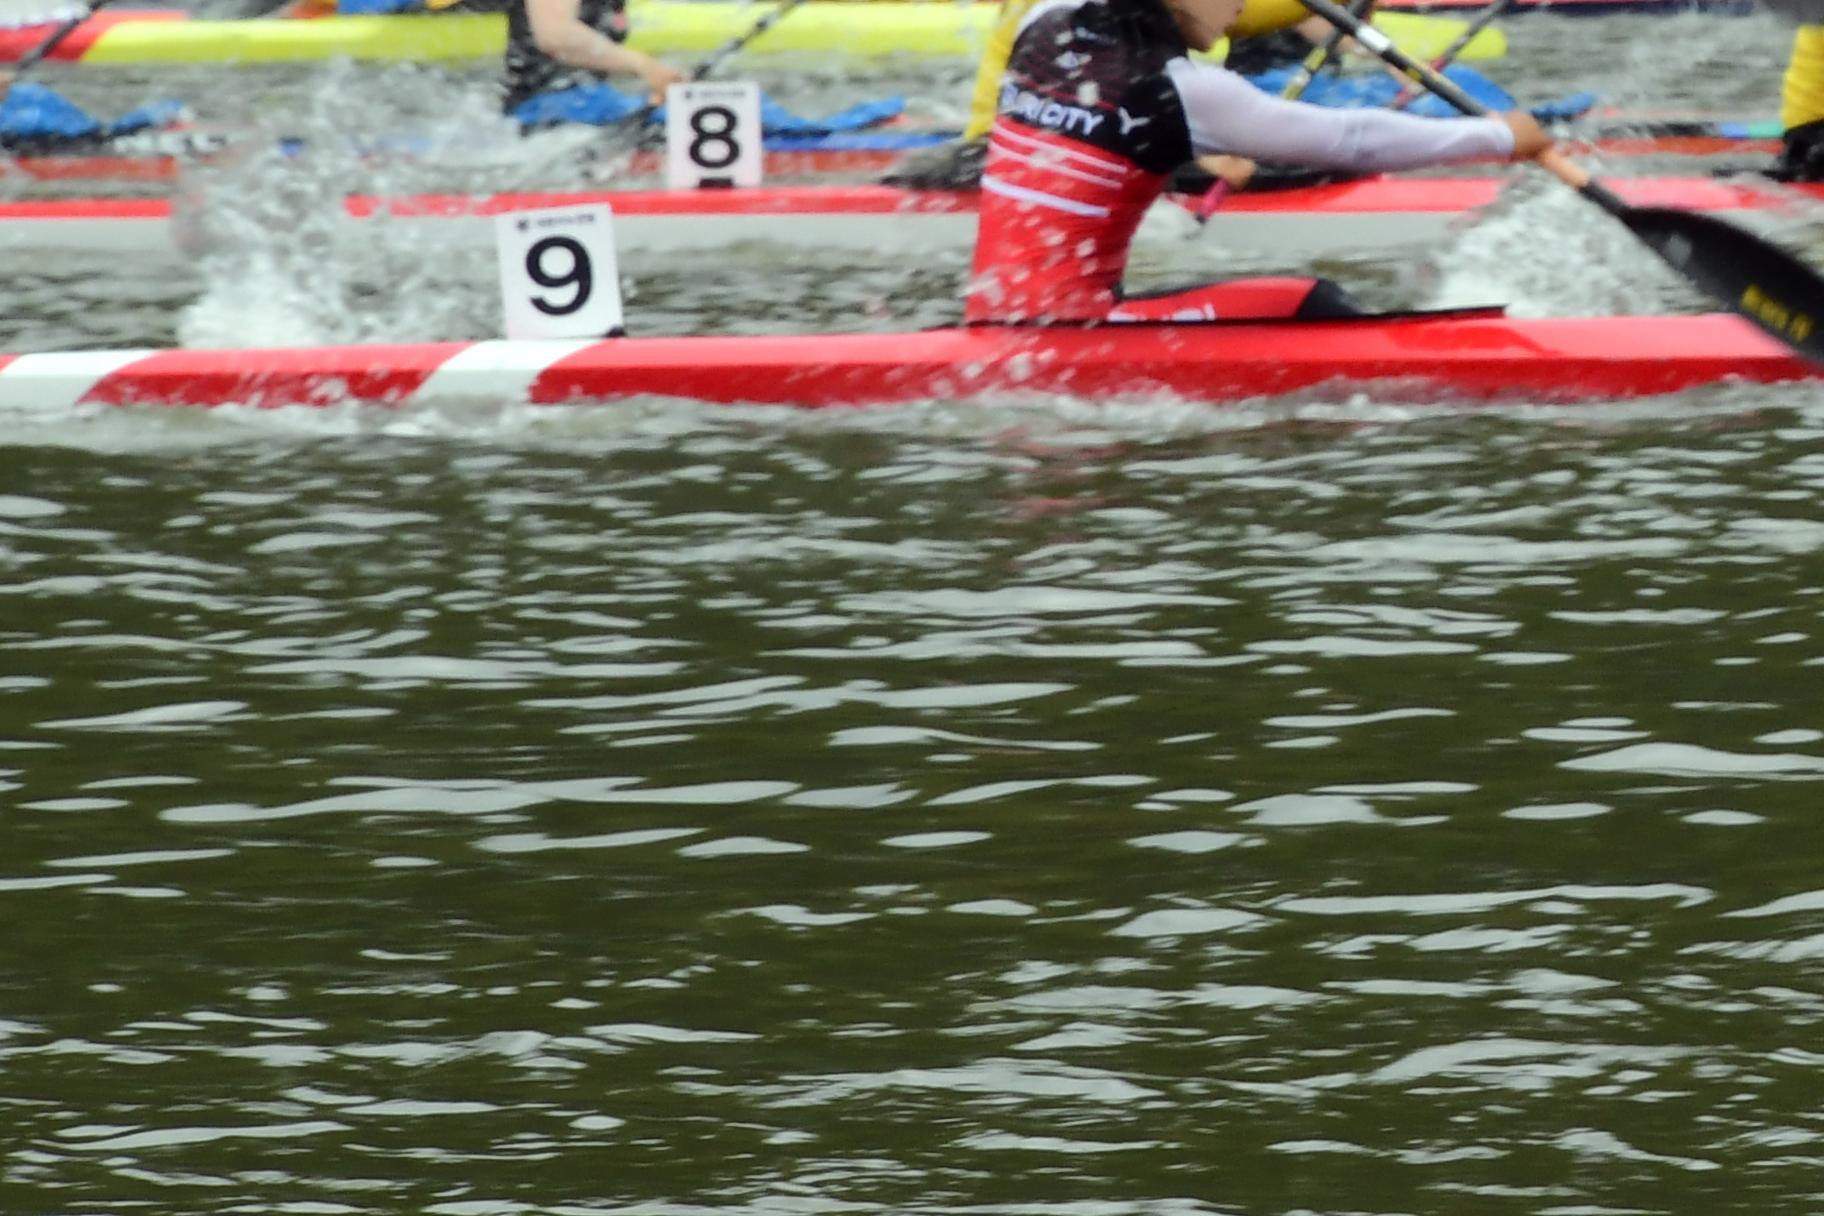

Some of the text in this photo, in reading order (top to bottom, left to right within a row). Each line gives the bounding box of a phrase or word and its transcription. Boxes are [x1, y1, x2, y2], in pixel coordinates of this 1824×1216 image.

[688, 106, 740, 169] 8
[1040, 102, 1104, 136] CITY
[525, 235, 593, 316] 9
